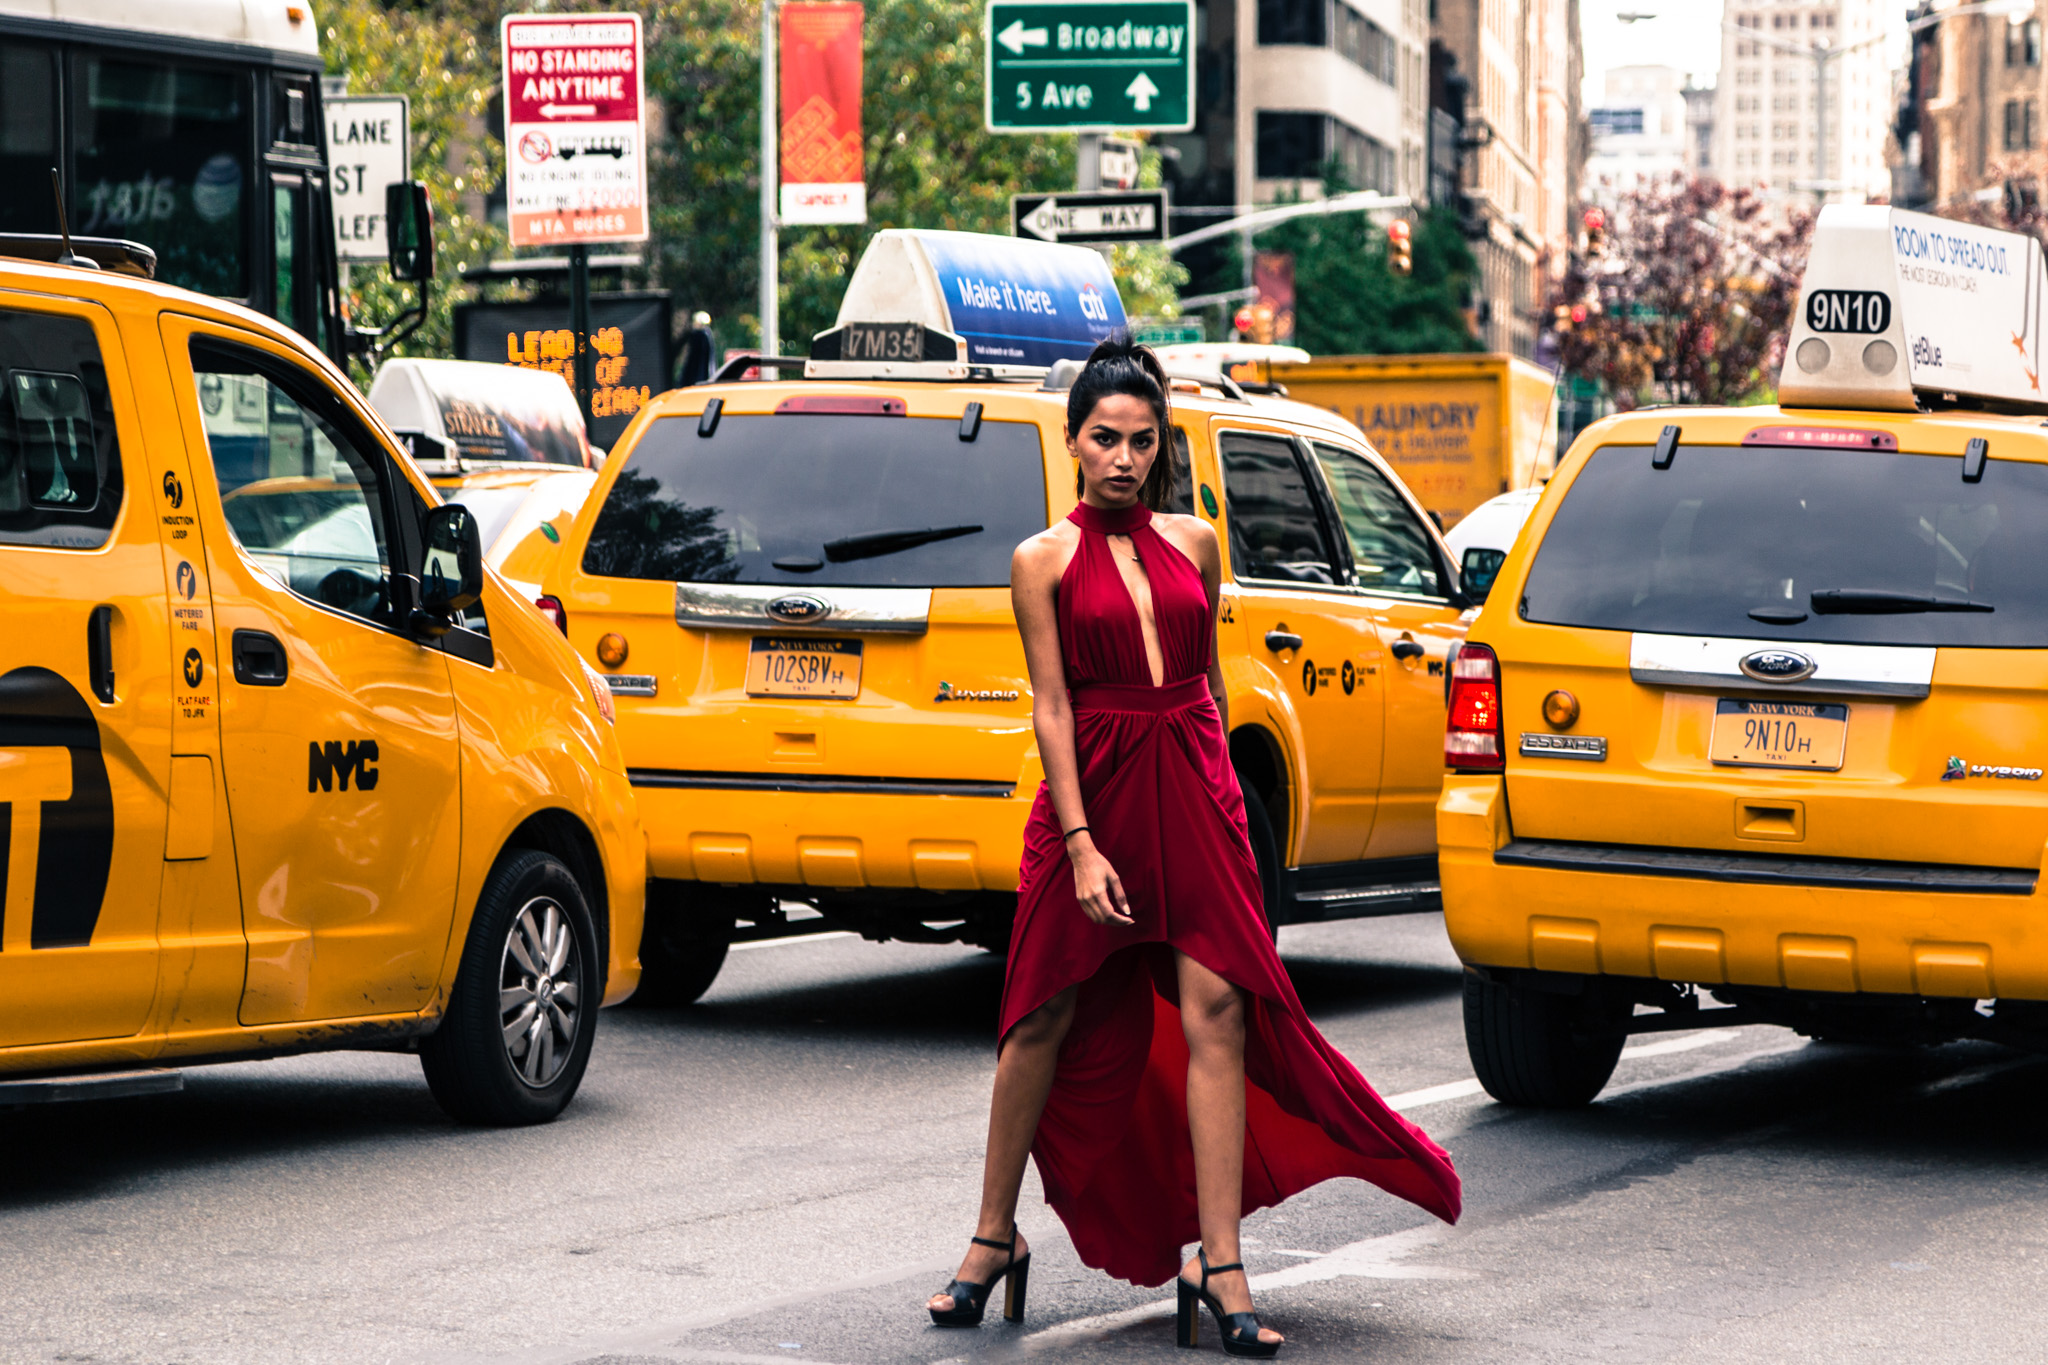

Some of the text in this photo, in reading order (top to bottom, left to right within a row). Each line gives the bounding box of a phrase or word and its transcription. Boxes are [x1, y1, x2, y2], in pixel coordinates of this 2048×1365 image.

[1057, 19, 1184, 56] Broadway
[511, 48, 634, 74] NO STANDING
[522, 76, 625, 101] ANYTIME
[1016, 80, 1093, 110] 5 Ave
[333, 119, 392, 145] LANE
[339, 214, 387, 241] LEF
[529, 214, 627, 236] MTA BUSES
[1036, 205, 1145, 232] ONE WAY
[1894, 224, 2011, 276] ROOM TO SPREAD OUT.
[957, 277, 1058, 316] Make it here.
[1078, 284, 1109, 321] citi
[1812, 292, 1884, 333] 9N10
[851, 328, 916, 358] 7M35
[1911, 334, 1942, 371] jetBlue
[1354, 401, 1480, 431] LAUNDRY
[162, 516, 194, 526] INDUCTION
[172, 530, 188, 540] LOOP
[174, 609, 204, 620] METERED
[182, 621, 198, 632] FARE
[780, 641, 836, 653] NEW YORK
[177, 696, 210, 706] FLAT FARE
[955, 689, 1019, 701] HYBRID
[183, 708, 205, 718] TO JFK
[1748, 703, 1817, 717] NEW YORK
[1526, 737, 1599, 751] ESCAPE
[308, 740, 379, 793] NYC
[1766, 753, 1787, 761] TAXI
[1969, 764, 2043, 780] HYBRID
